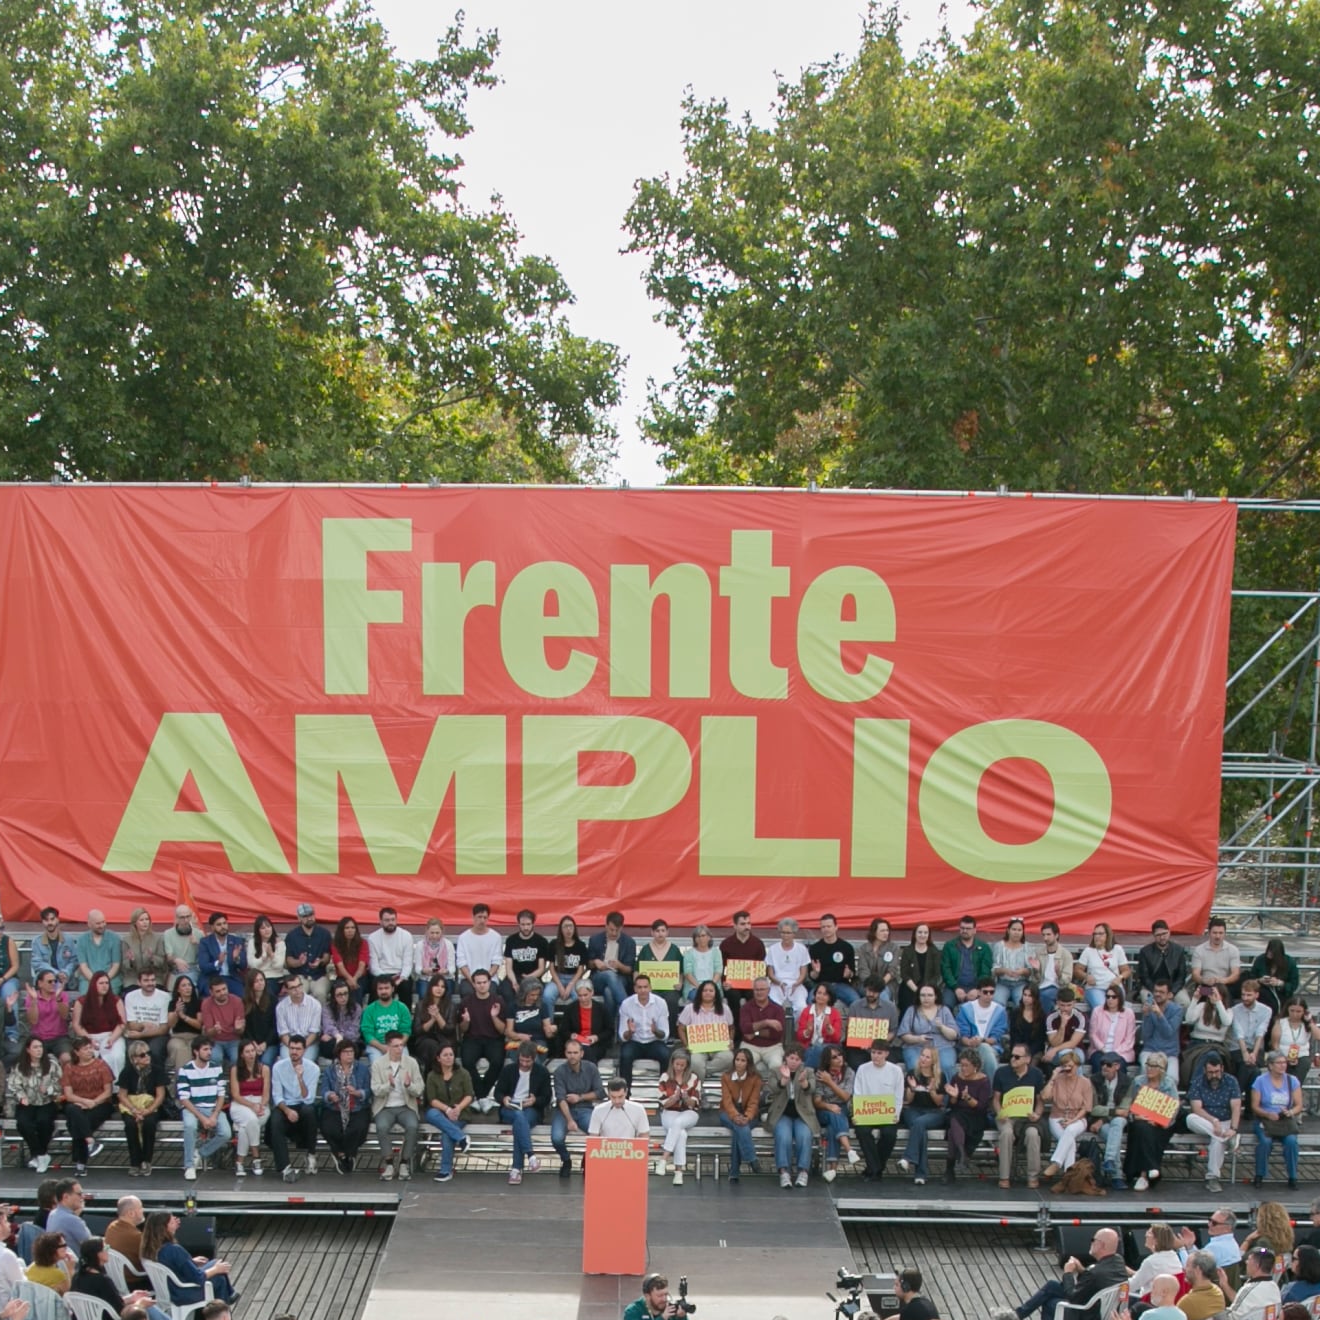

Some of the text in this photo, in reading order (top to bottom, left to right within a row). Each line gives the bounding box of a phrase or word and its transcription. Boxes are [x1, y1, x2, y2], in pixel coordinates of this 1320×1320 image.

[322, 517, 896, 703] Frente
[101, 712, 1114, 883] AMPLIO
[688, 1023, 728, 1035] AMPLIO
[848, 1018, 889, 1029] AMPLIO
[863, 1100, 887, 1108] Frente
[855, 1107, 896, 1116] AMPLIO
[601, 1139, 633, 1150] Frente
[590, 1149, 646, 1160] AMPLIO
